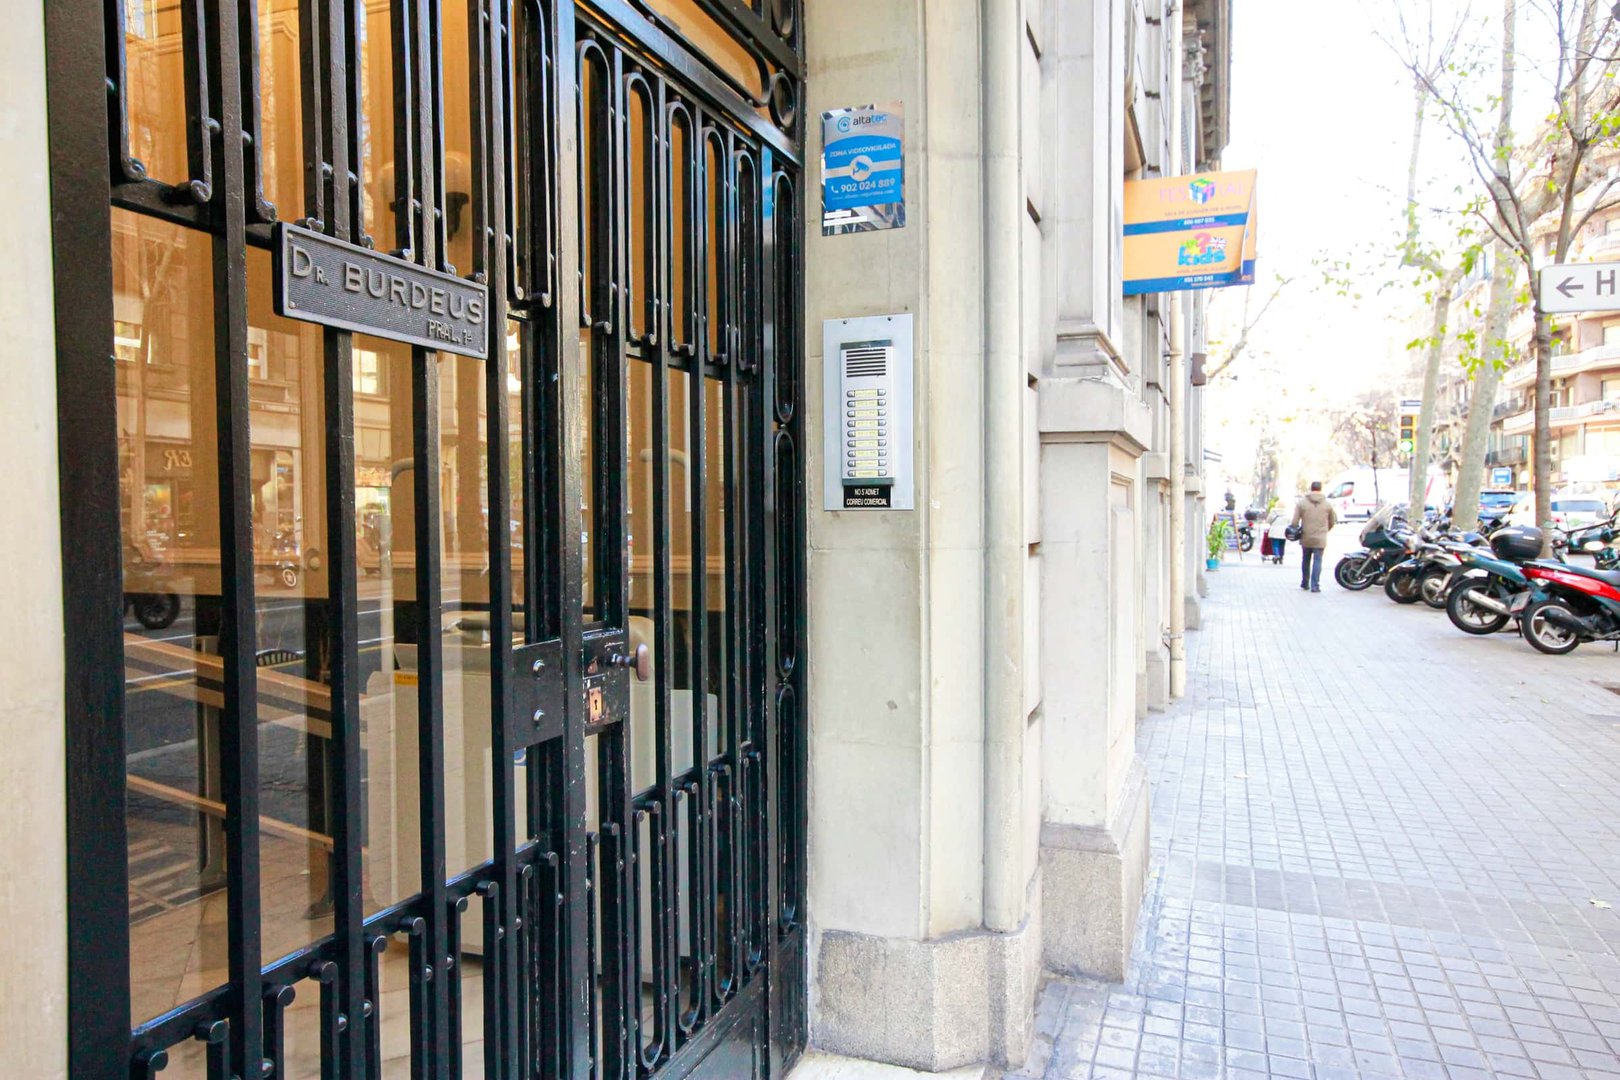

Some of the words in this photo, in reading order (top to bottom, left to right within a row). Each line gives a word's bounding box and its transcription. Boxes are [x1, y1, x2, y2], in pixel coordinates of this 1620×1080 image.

[841, 183, 857, 193] 902
[859, 180, 876, 191] 024
[1178, 245, 1226, 266] kids
[343, 261, 483, 325] BURDEUS
[854, 488, 861, 496] NO
[846, 498, 864, 506] CORREU
[864, 498, 888, 506] COMERCIAL
